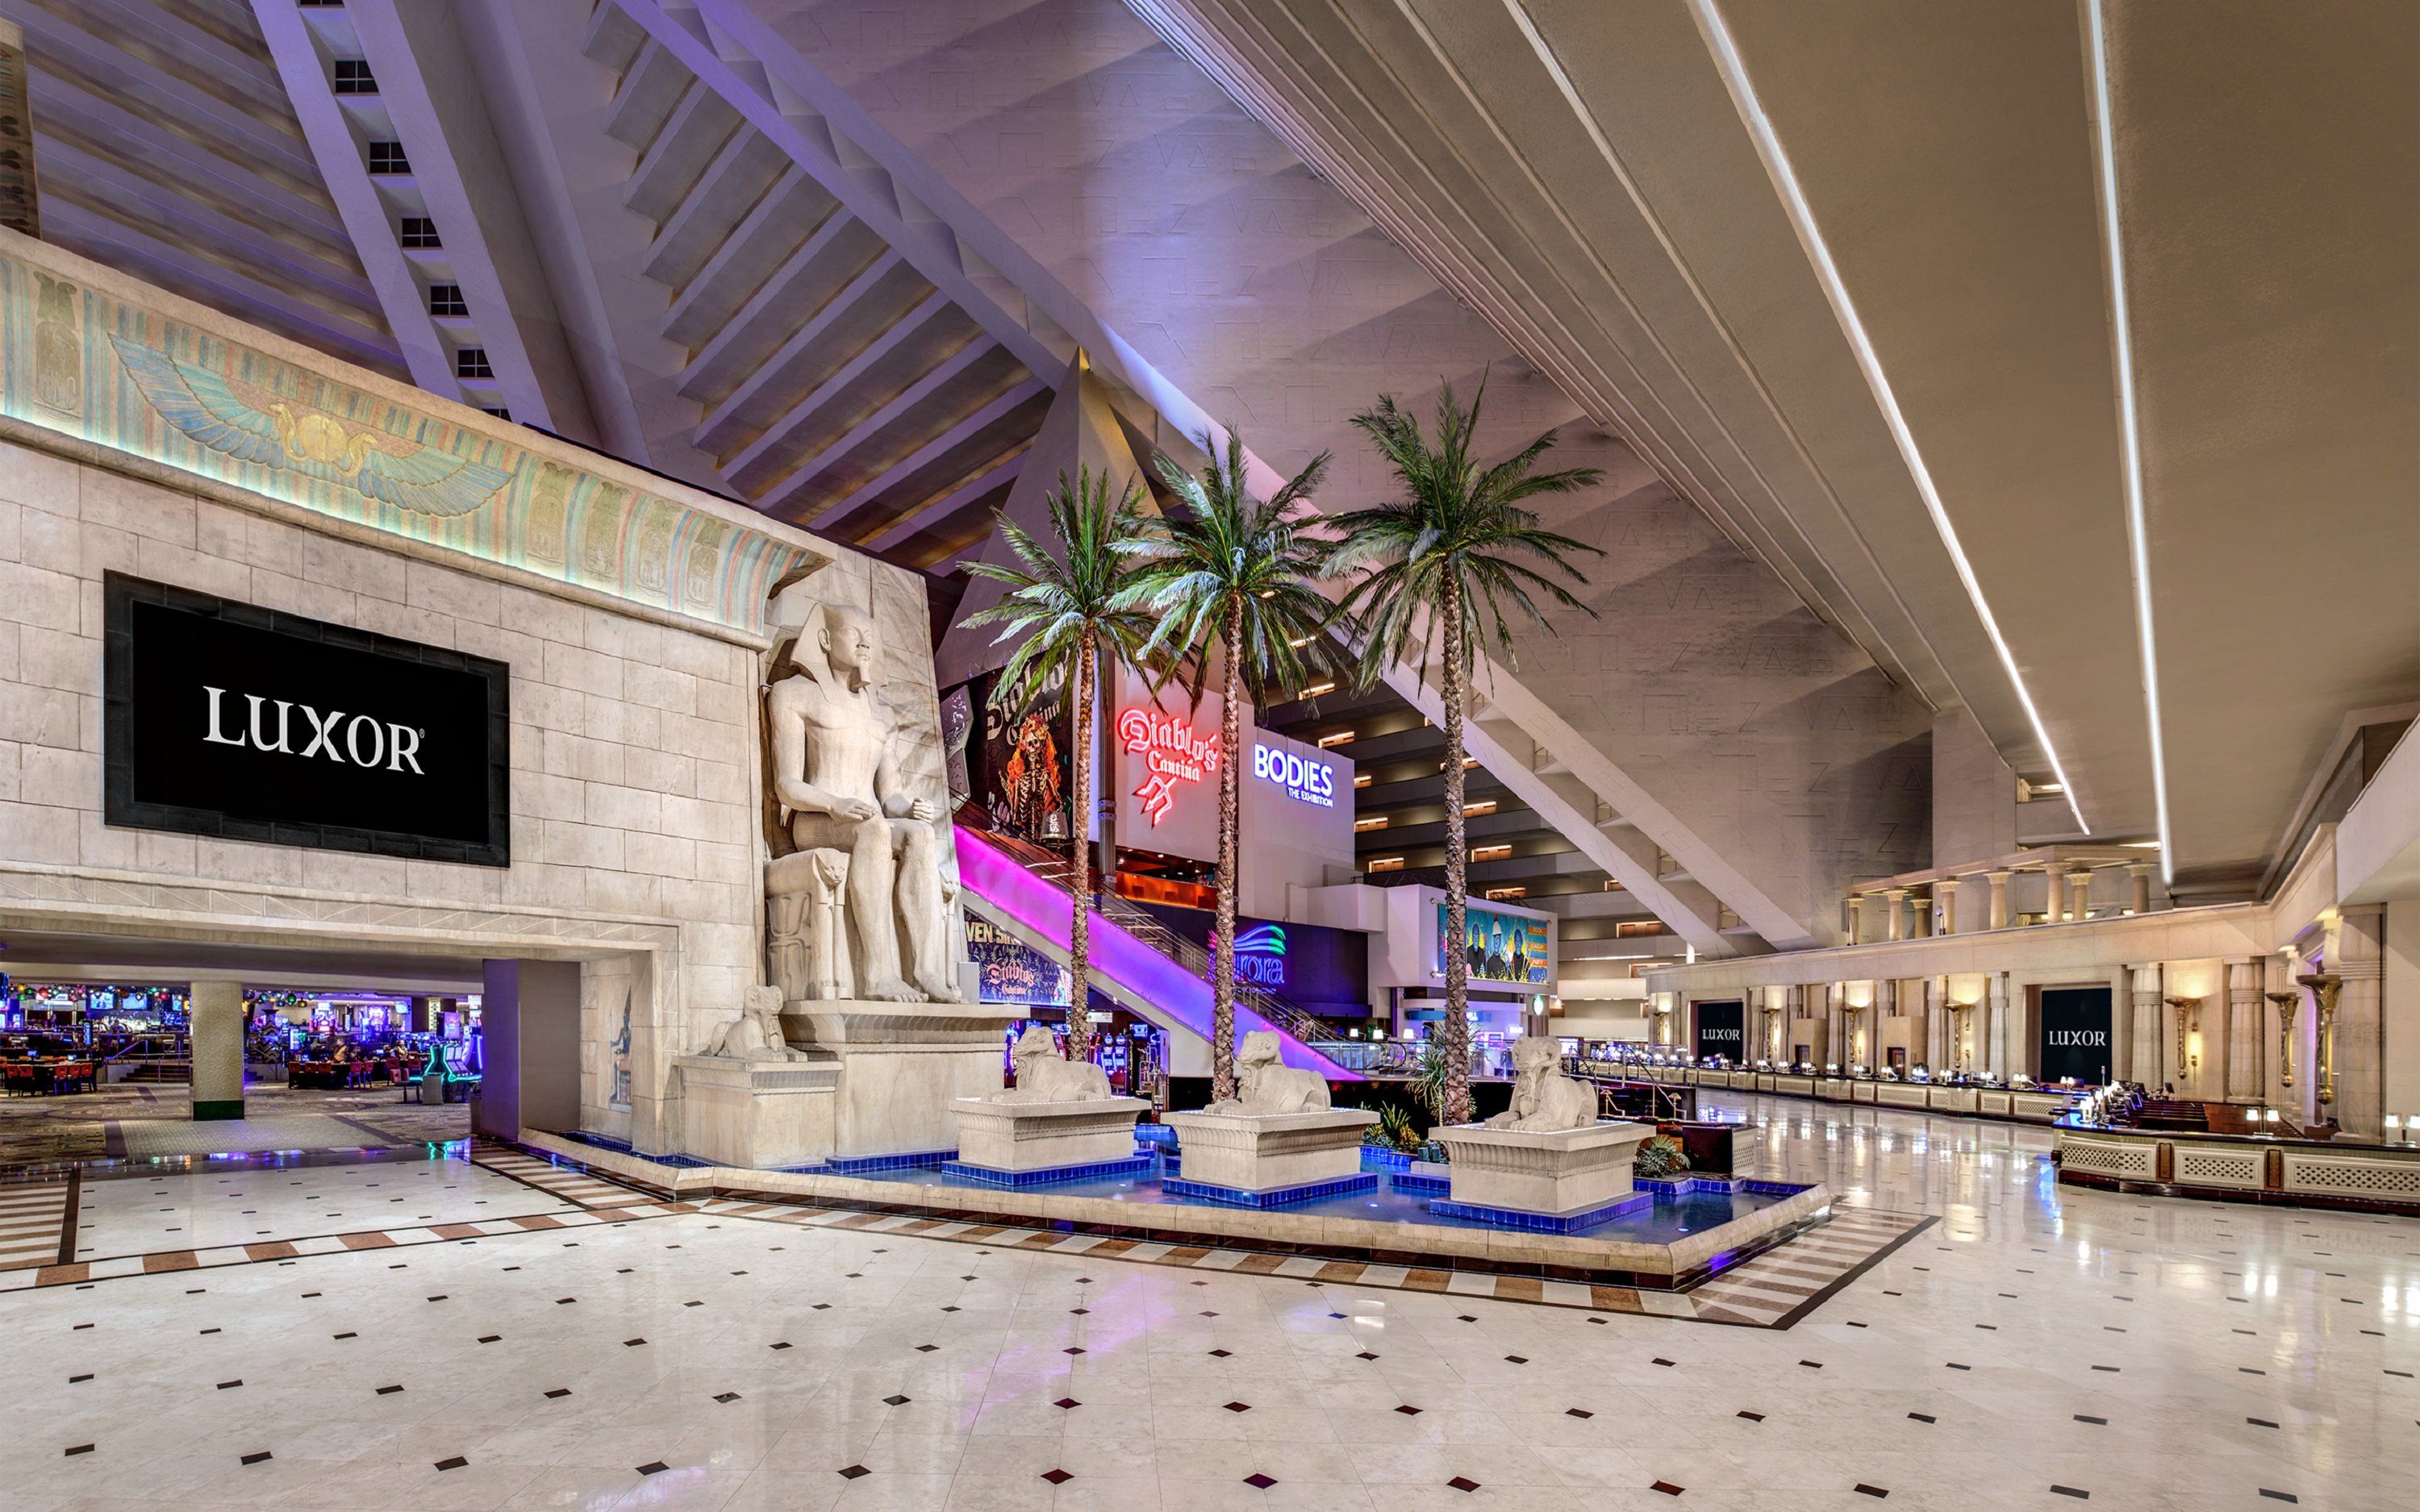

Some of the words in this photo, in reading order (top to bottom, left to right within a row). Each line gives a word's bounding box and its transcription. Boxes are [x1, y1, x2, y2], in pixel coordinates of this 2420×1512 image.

[1118, 709, 1219, 772] Diablo's
[1254, 743, 1333, 798] BODIES
[1287, 786, 1300, 799] THE
[1300, 790, 1333, 808] EXHIBITION
[1702, 1028, 1741, 1040] LUXOR
